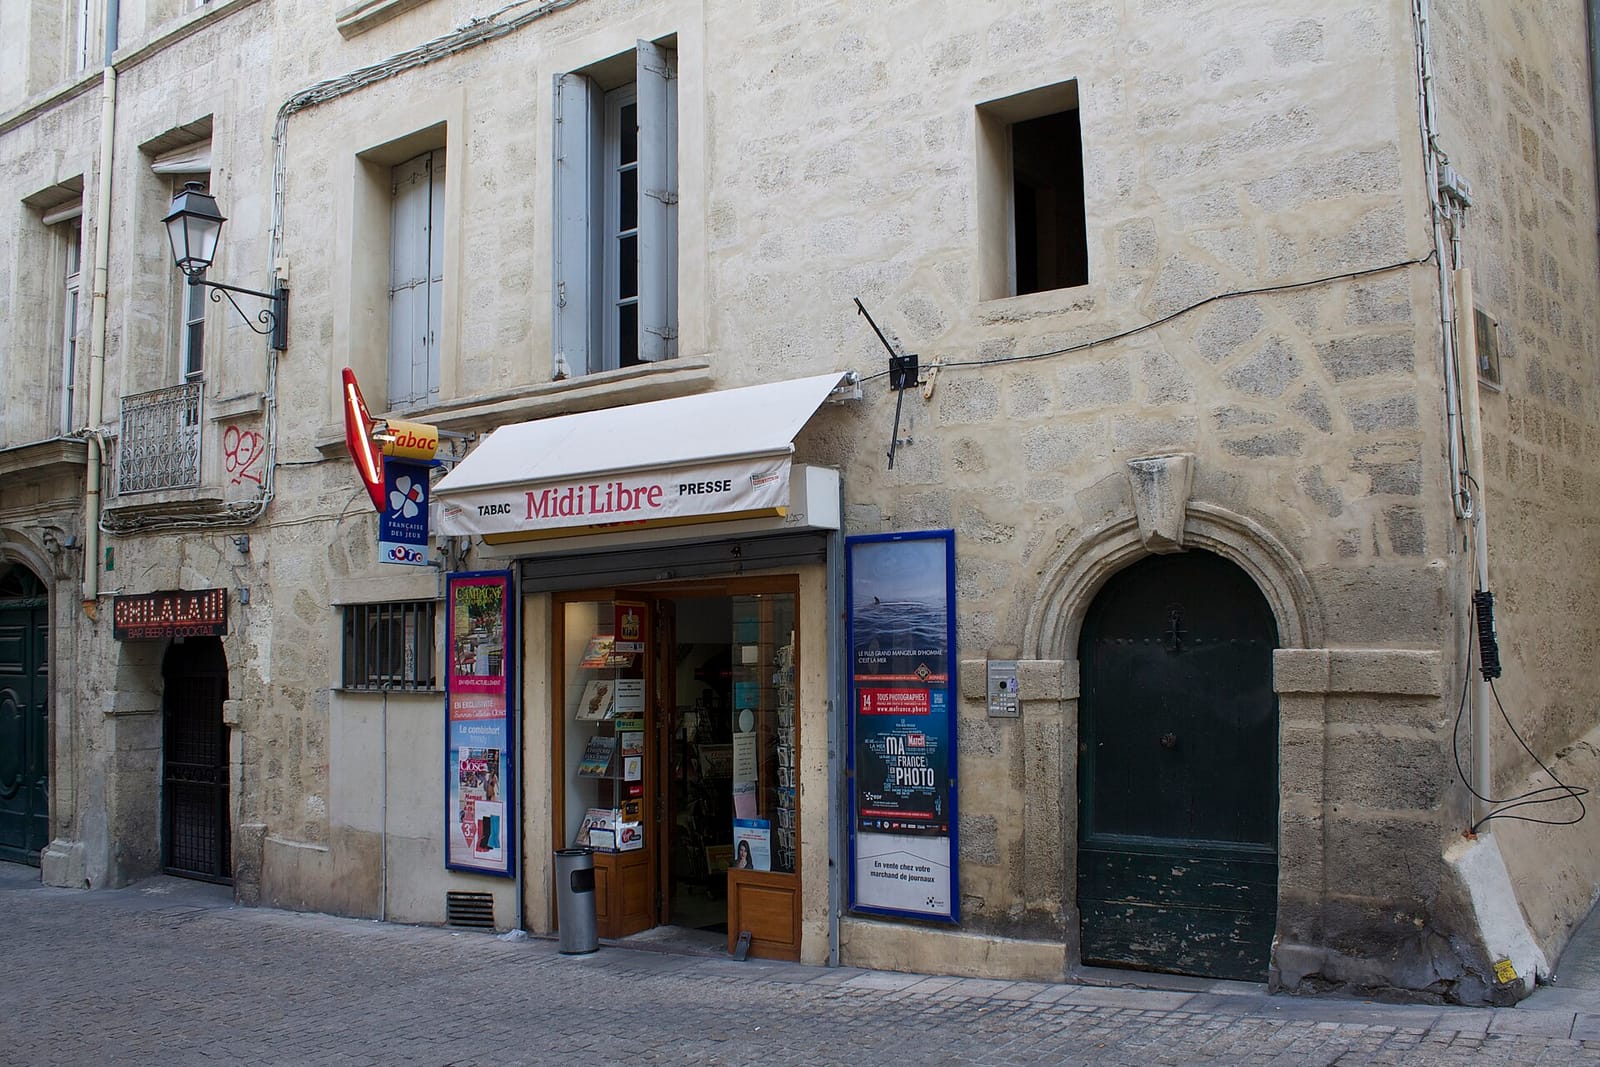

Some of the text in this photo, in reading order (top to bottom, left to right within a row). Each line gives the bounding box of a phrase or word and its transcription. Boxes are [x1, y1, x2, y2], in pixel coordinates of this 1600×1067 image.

[386, 428, 436, 450] Tabac
[478, 503, 511, 516] TABAC
[525, 485, 585, 520] Midi
[588, 482, 663, 514] Libre
[679, 480, 732, 496] PRESSE
[388, 521, 424, 532] FRANÇAISE
[388, 545, 424, 563] LOTO
[128, 628, 143, 638] BAR
[145, 627, 164, 637] BEER
[175, 625, 216, 636] COCKTAIL
[863, 694, 871, 707] 14
[886, 736, 905, 755] MA
[897, 756, 926, 768] FRANCE
[896, 767, 934, 787] PHOTO
[874, 860, 931, 873] En vente chez votre
[870, 871, 935, 883] marchand de journaux
